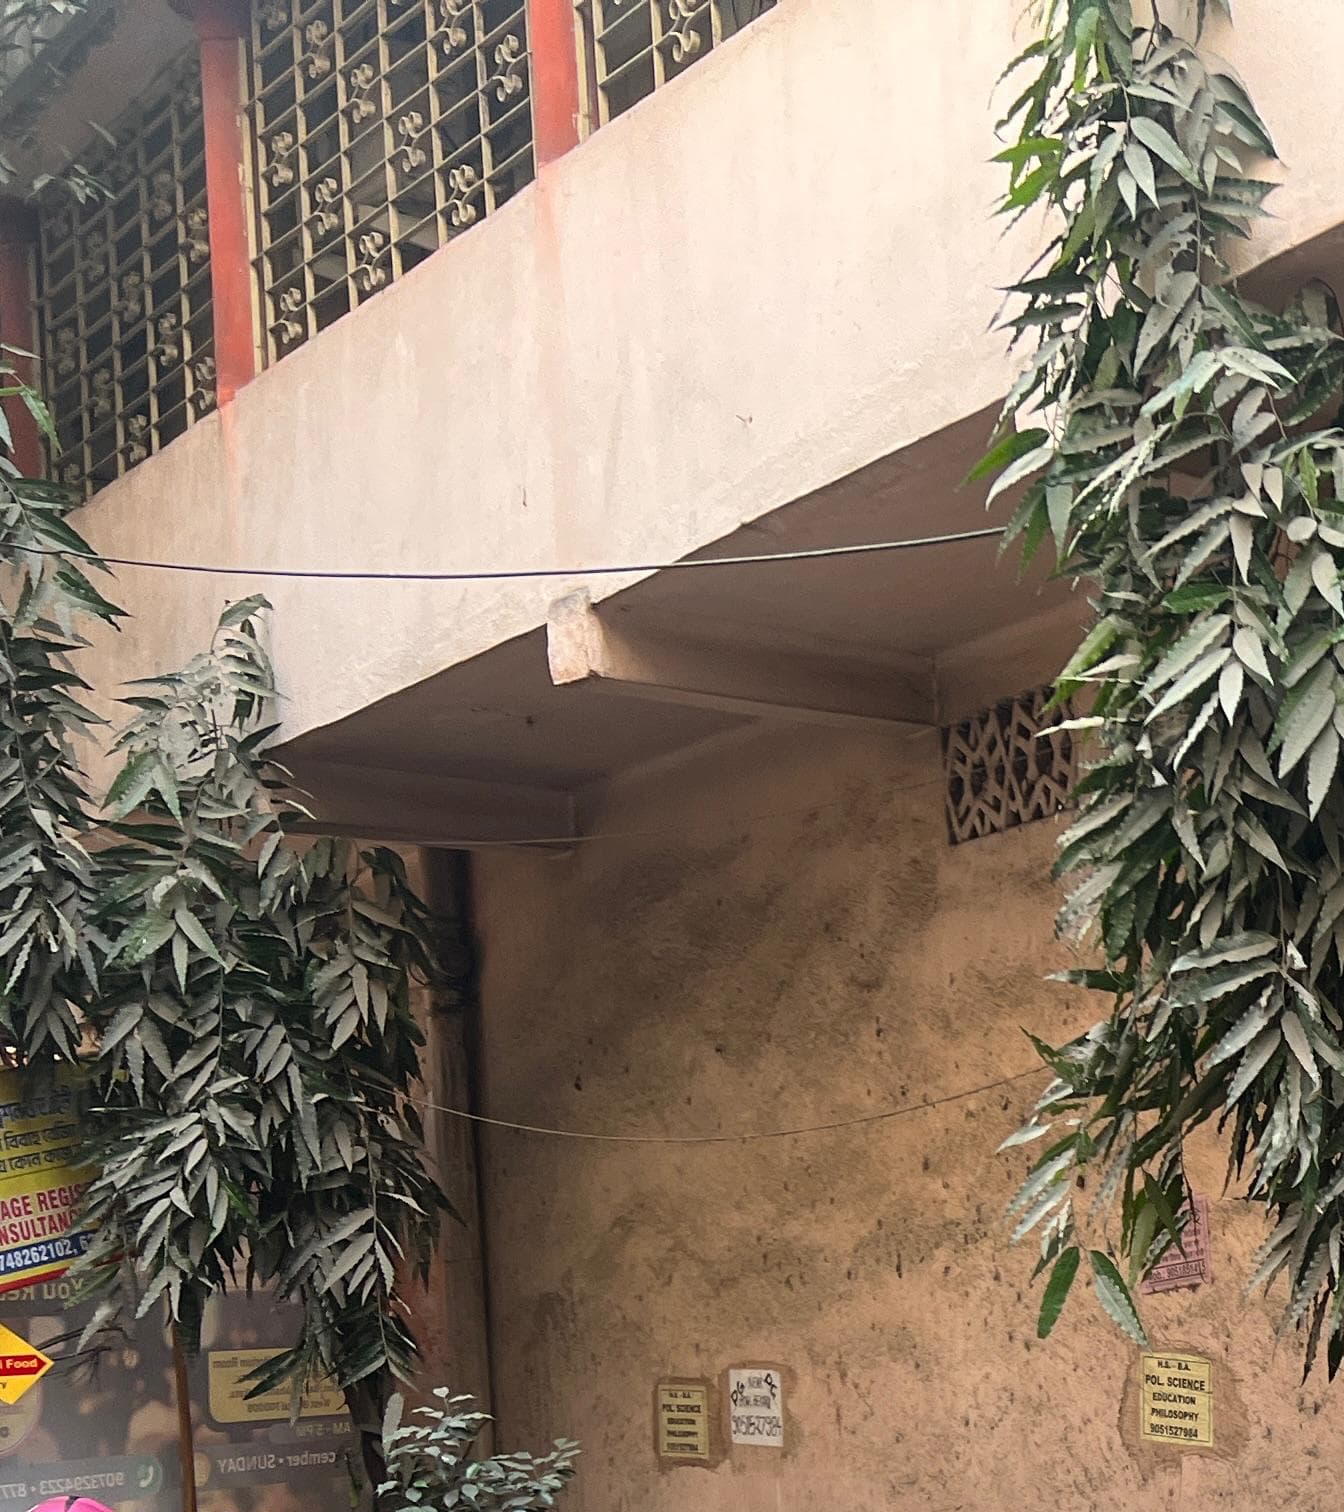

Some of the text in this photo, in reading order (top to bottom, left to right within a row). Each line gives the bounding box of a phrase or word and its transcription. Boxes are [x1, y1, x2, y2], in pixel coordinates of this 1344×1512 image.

[6, 1359, 38, 1368] Food
[1167, 1376, 1205, 1390] SCIENCE
[1152, 1392, 1196, 1405] EDUCATION
[1151, 1408, 1199, 1422] PHILOSOPHY
